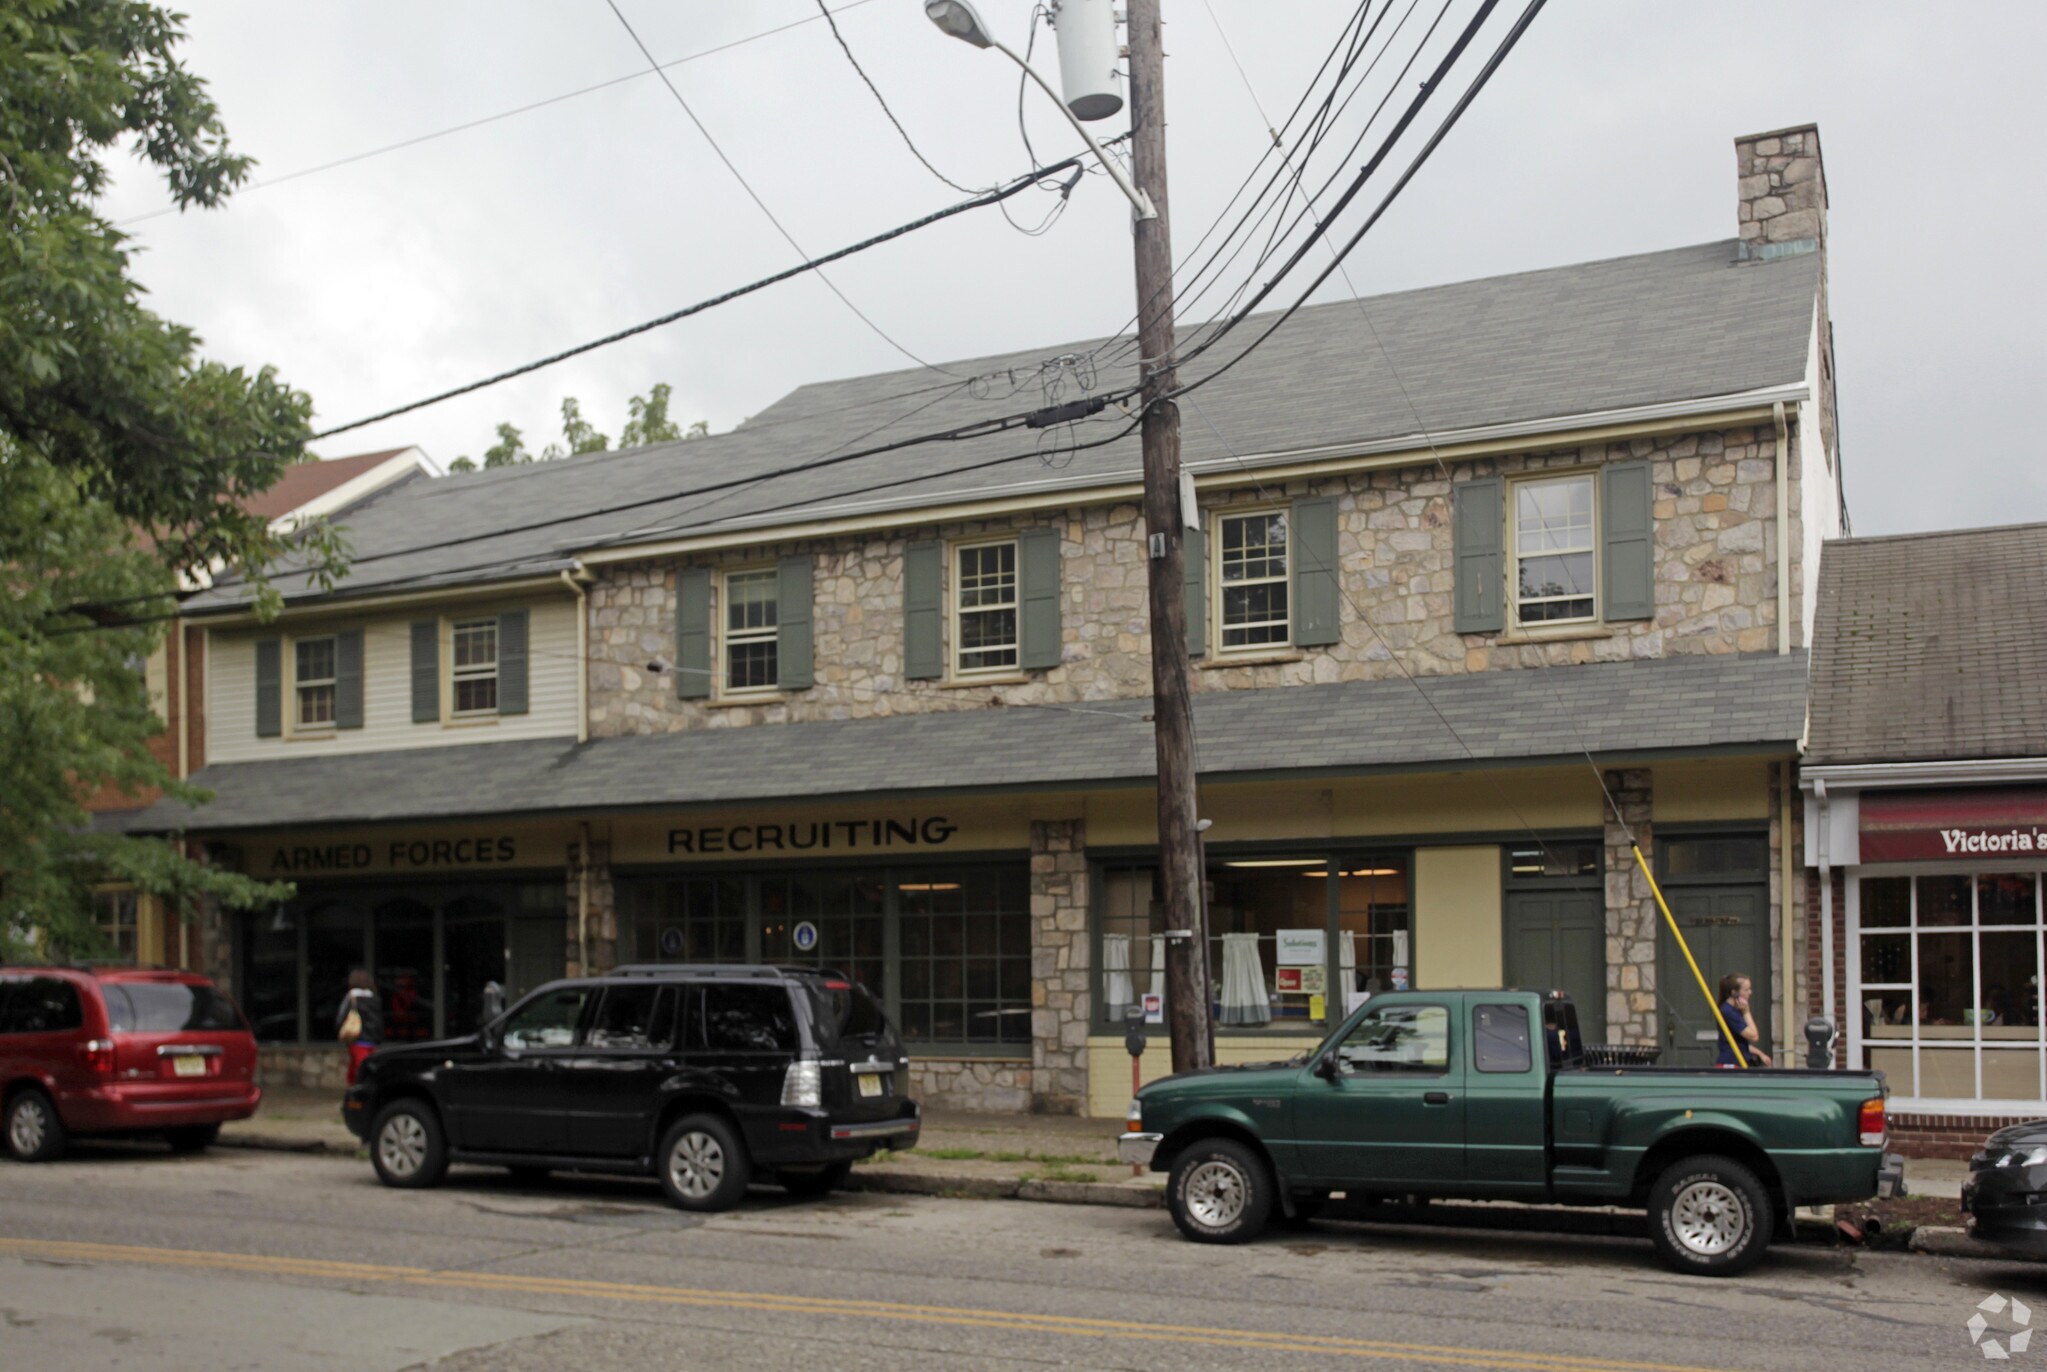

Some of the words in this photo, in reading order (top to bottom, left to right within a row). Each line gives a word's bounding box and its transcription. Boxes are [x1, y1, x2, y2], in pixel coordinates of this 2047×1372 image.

[667, 816, 958, 854] RECRUITING
[1940, 827, 2047, 853] Victoria's
[271, 843, 372, 871] ARMED
[388, 836, 516, 866] FORCES
